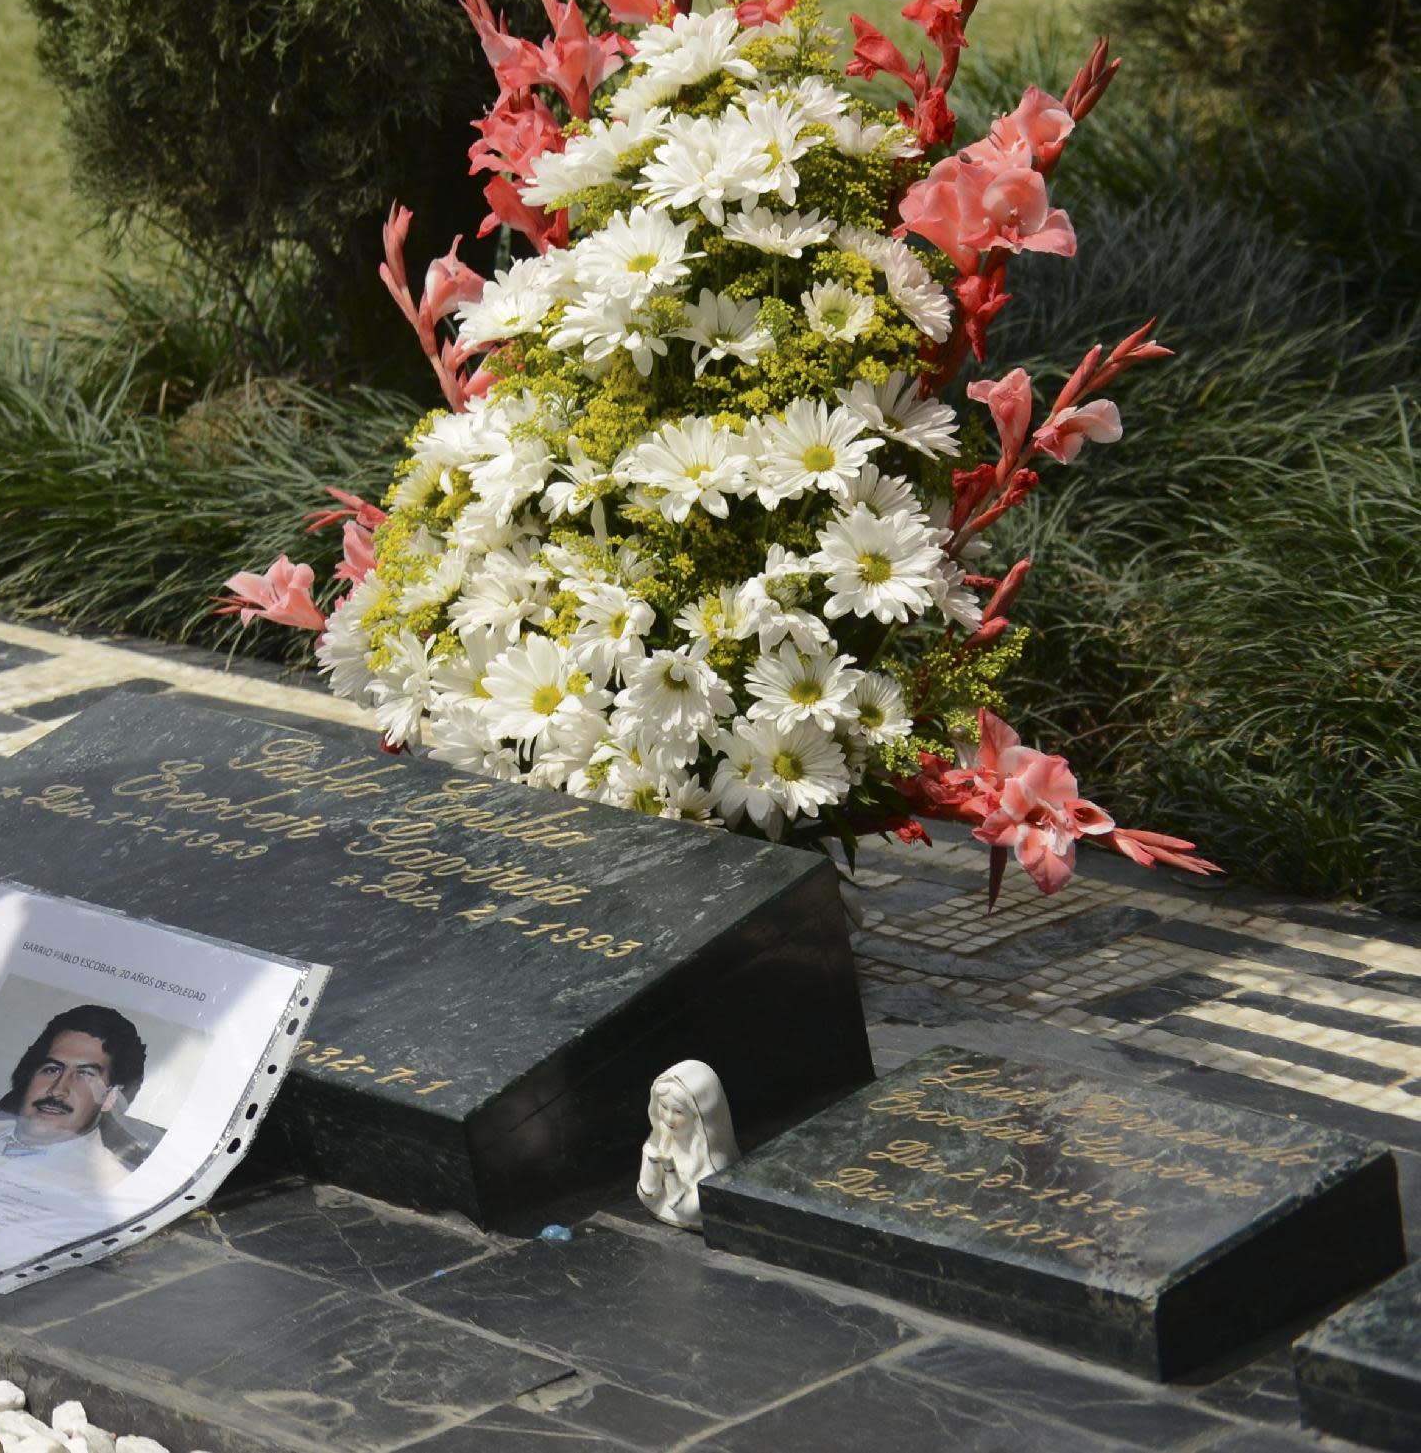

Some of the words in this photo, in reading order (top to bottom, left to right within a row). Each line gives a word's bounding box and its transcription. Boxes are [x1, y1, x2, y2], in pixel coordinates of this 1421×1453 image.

[22, 783, 96, 820] Dic.
[111, 759, 327, 840] Escobar
[344, 817, 592, 906] Gaviria
[229, 738, 406, 798] Pablo
[404, 778, 596, 849] Emilio
[360, 870, 444, 911] Dic.
[22, 941, 53, 958] BARRIO
[54, 950, 79, 965] PABLO
[119, 969, 130, 981] 20
[130, 972, 154, 989] AÑOS
[155, 979, 167, 991] DE
[167, 983, 207, 1002] SOLEDAD
[868, 1089, 1051, 1145] Escobar
[1060, 1132, 1266, 1198] Gaviria
[918, 1064, 1050, 1106] Luis
[1060, 1094, 1321, 1166] Fernando
[813, 1166, 896, 1204] Dic.
